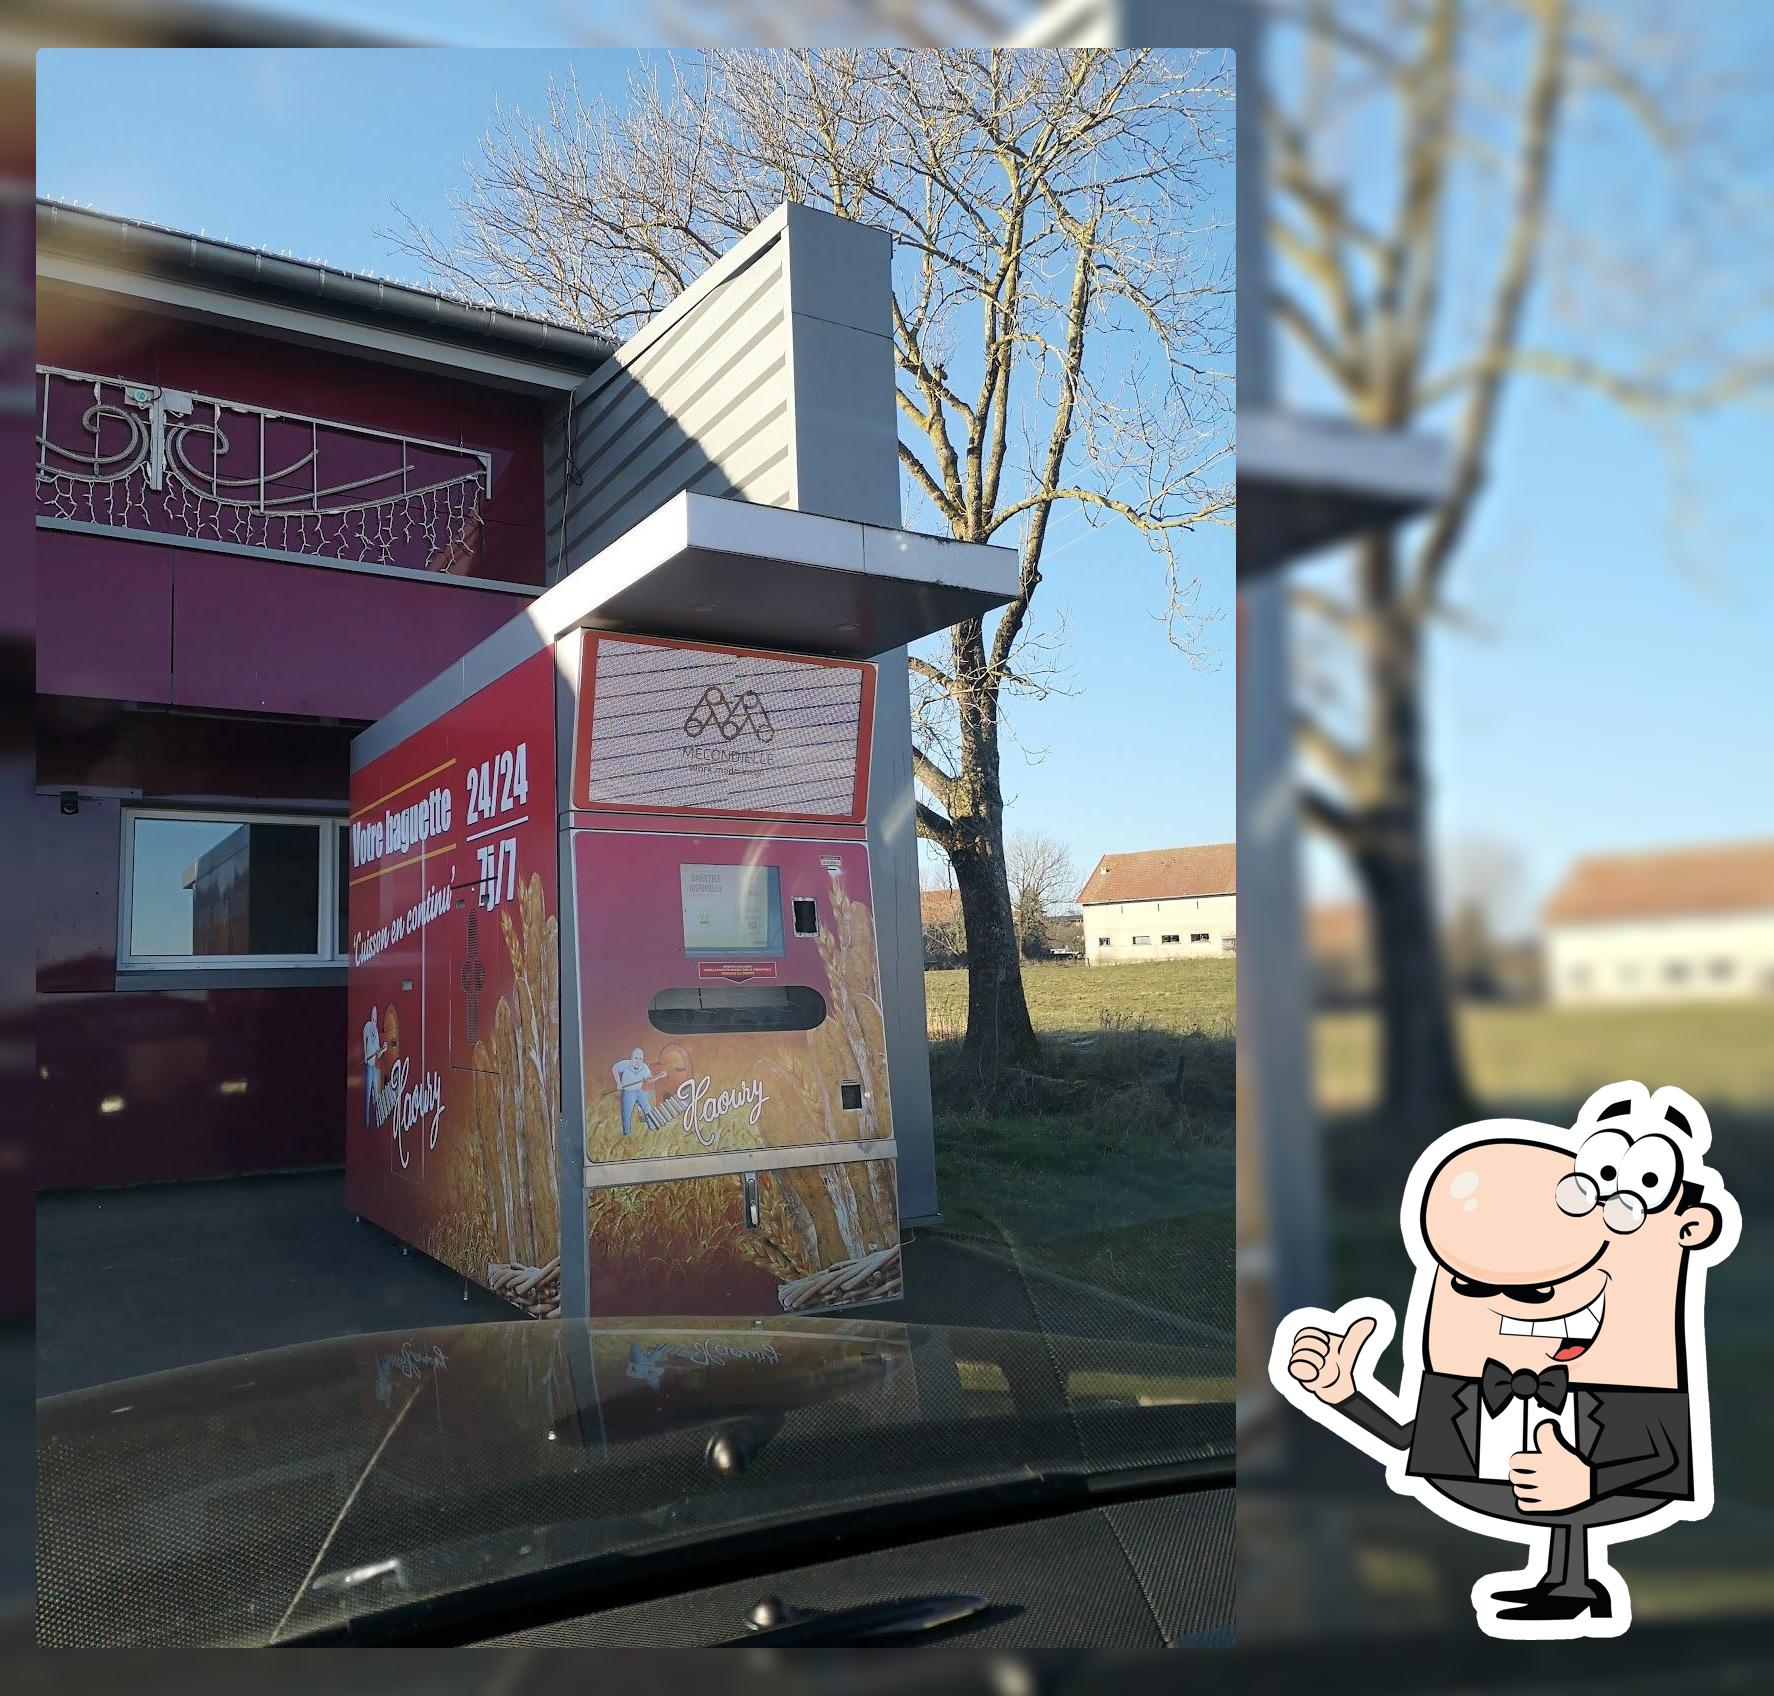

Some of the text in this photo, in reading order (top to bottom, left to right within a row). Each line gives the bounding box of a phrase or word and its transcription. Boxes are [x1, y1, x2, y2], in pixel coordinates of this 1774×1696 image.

[466, 742, 529, 826] 24/24
[352, 787, 452, 868] Votre baguette
[477, 837, 517, 912] 7j/7
[391, 916, 405, 944] en
[391, 1056, 446, 1169] Haoury
[677, 1075, 770, 1147] Haoury
